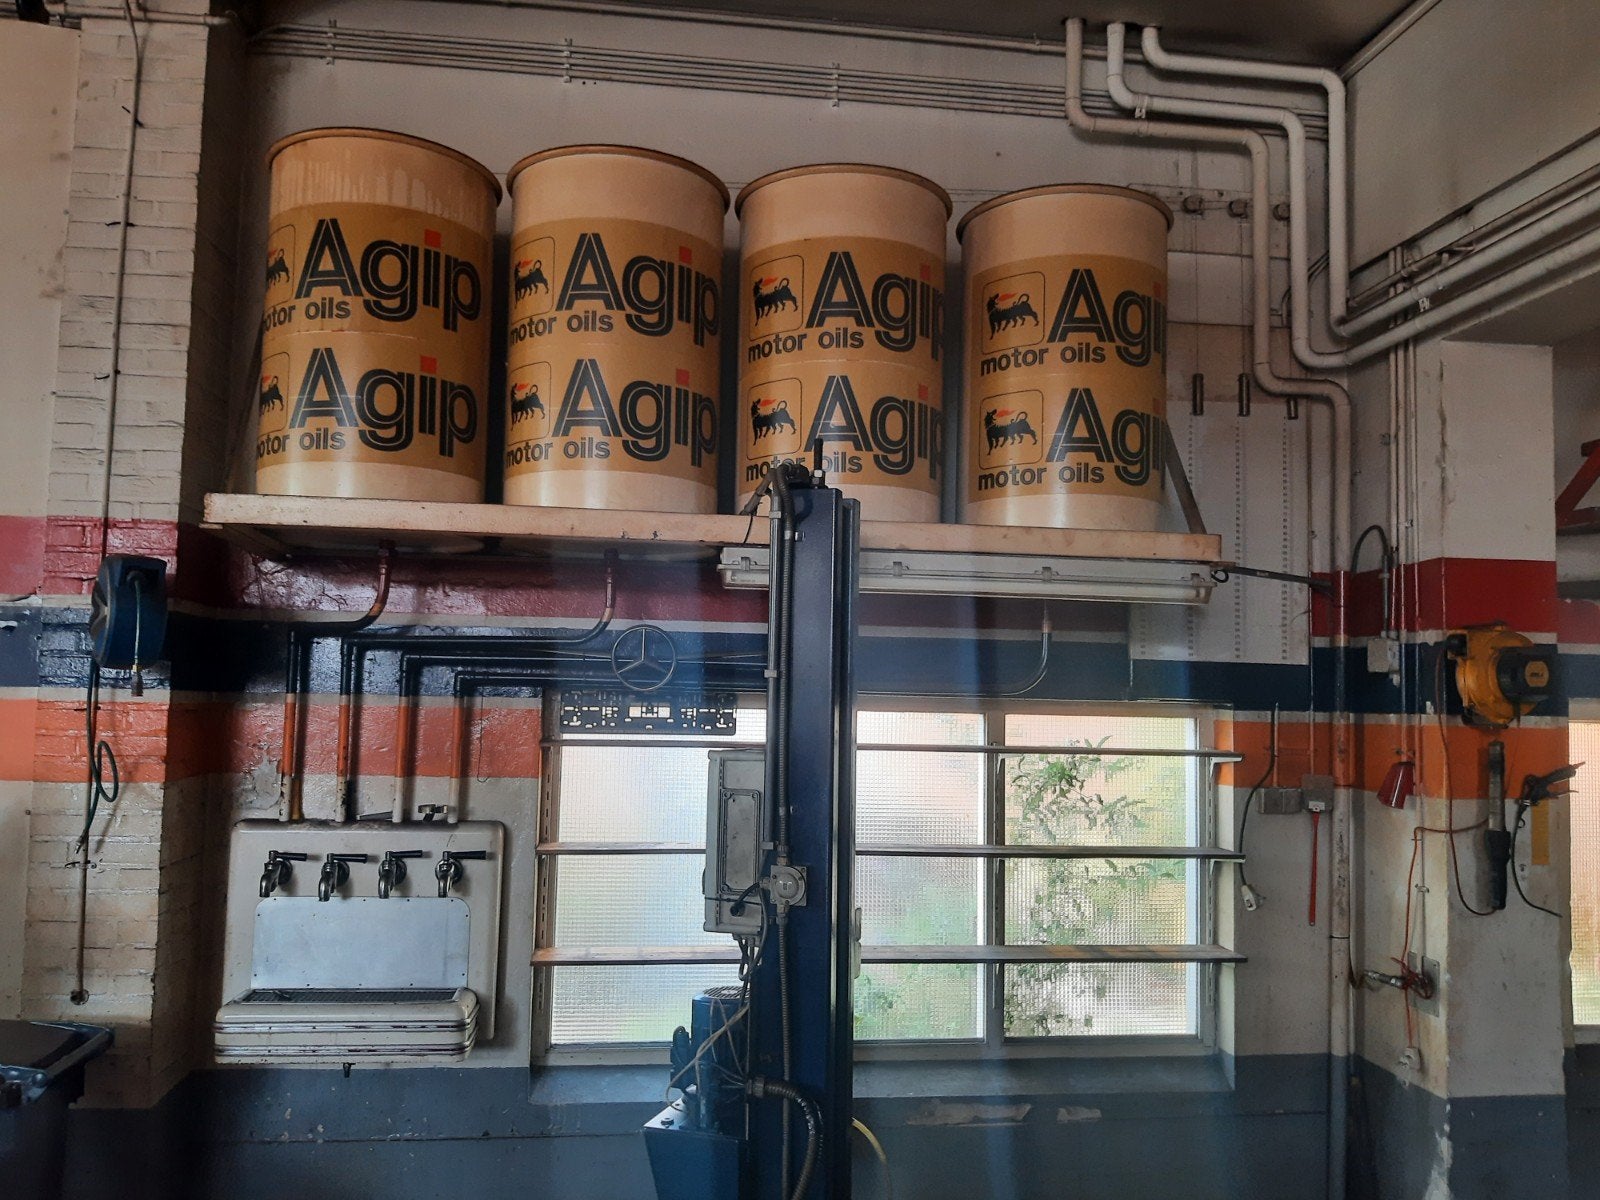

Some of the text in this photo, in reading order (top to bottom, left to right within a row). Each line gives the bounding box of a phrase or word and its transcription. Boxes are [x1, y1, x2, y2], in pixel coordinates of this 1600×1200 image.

[295, 218, 481, 332] Agip
[555, 232, 719, 348] Agip
[805, 251, 944, 361] Agip
[262, 297, 350, 332] otor oils
[566, 310, 614, 333] oils
[748, 327, 864, 363] motor oils
[1046, 268, 1166, 375] Agi
[980, 342, 1106, 377] motor oils
[288, 347, 477, 458] Agip
[551, 358, 717, 468] Agip
[803, 375, 943, 480] Agip
[256, 427, 346, 458] otor oils
[563, 437, 611, 460] oils
[822, 451, 863, 474] oils
[1045, 387, 1166, 490] Agi
[978, 462, 1105, 491] motor oils
